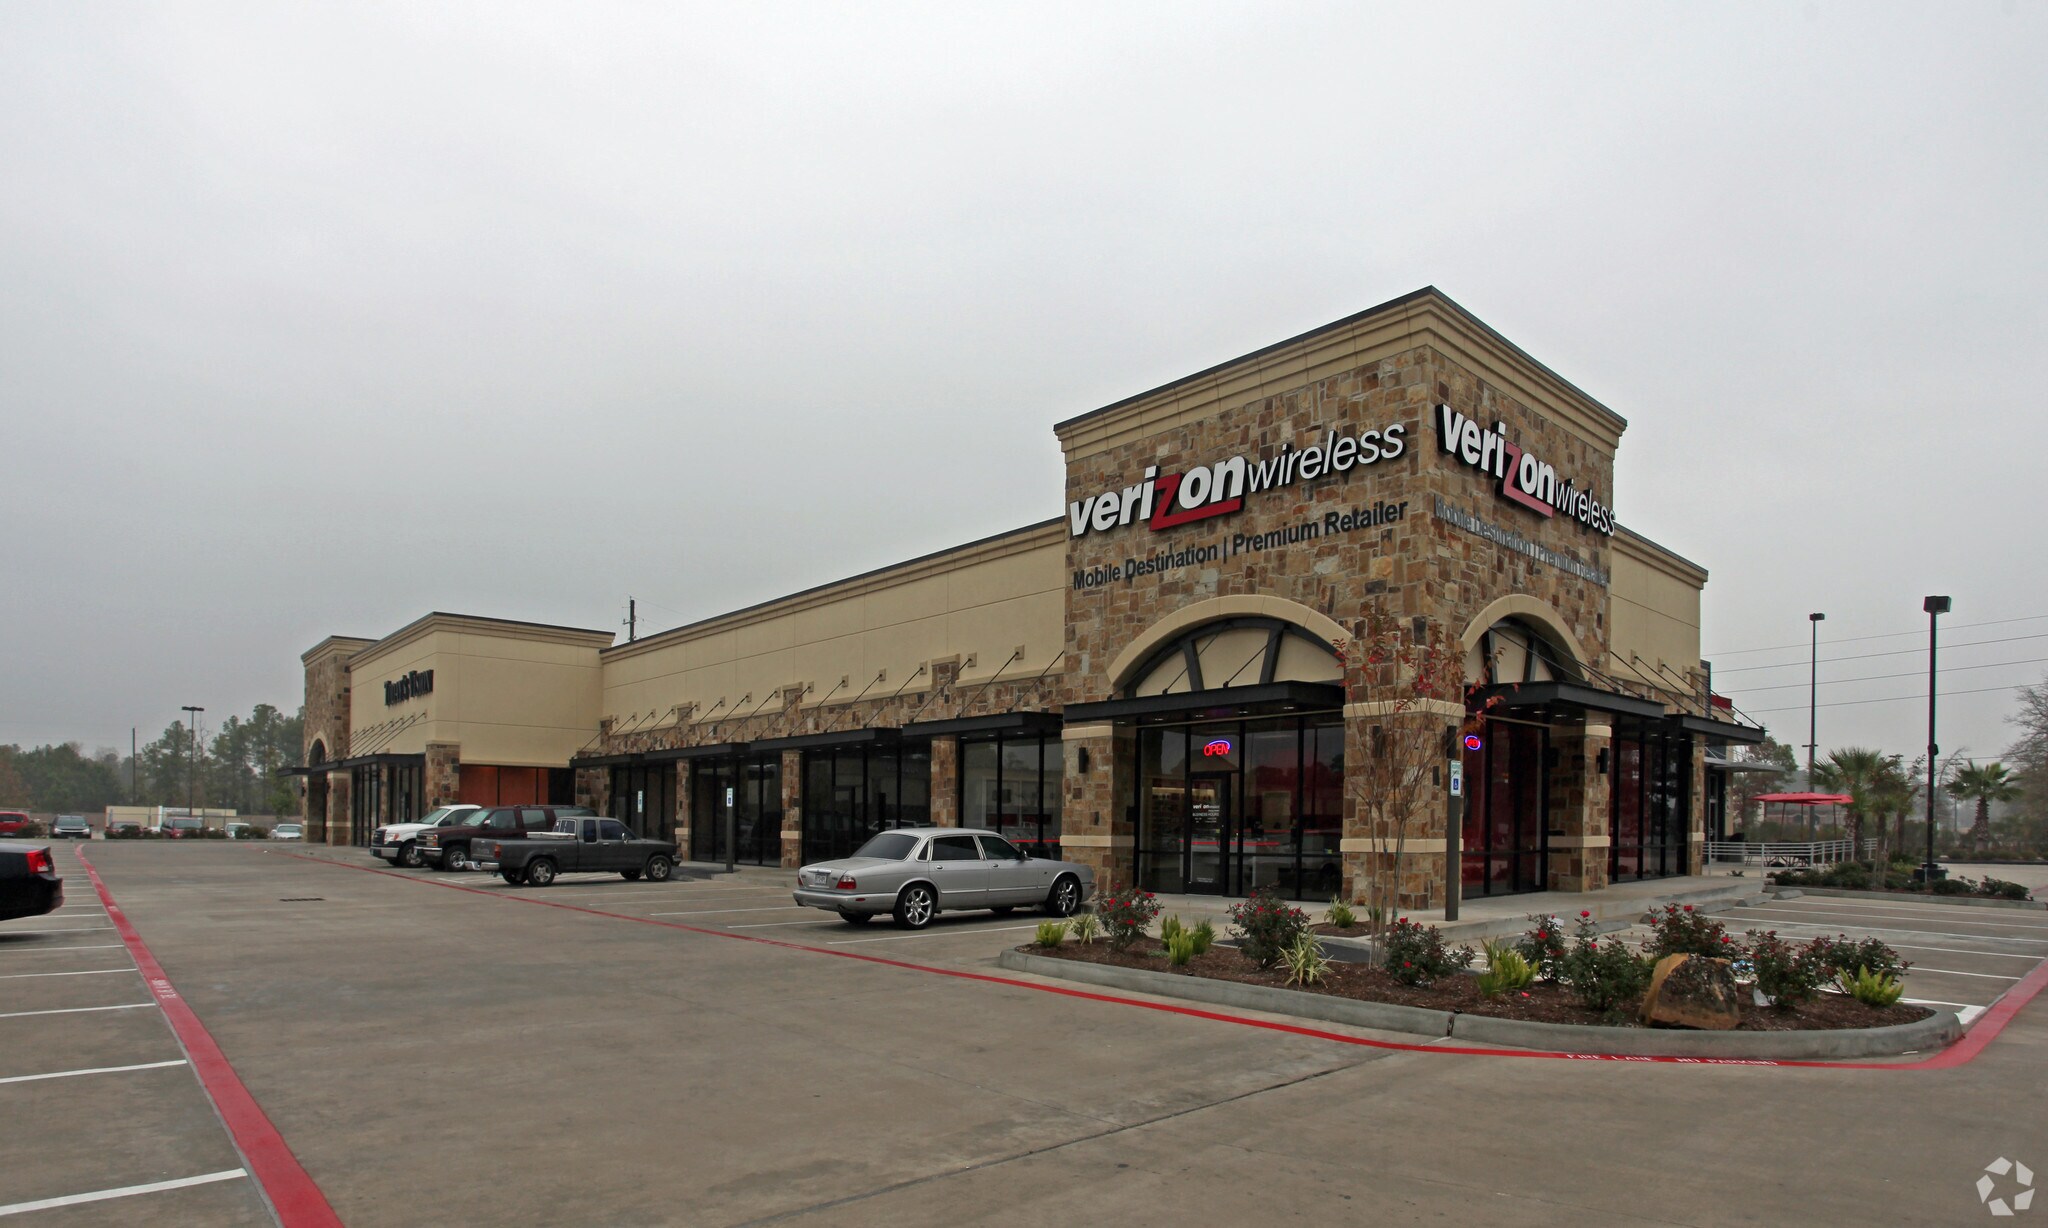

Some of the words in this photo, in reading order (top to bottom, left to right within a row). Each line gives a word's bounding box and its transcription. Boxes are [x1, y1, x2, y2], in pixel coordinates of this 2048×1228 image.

[1070, 456, 1247, 531] verizon
[1247, 424, 1409, 494] wireless
[1439, 404, 1555, 518] verizon
[1555, 478, 1616, 537] wireless
[1073, 564, 1121, 590] Mobile
[1125, 542, 1219, 580] Destination
[1232, 519, 1320, 556] Premium
[1324, 500, 1409, 535] Retailer
[1203, 744, 1228, 756] OPEN
